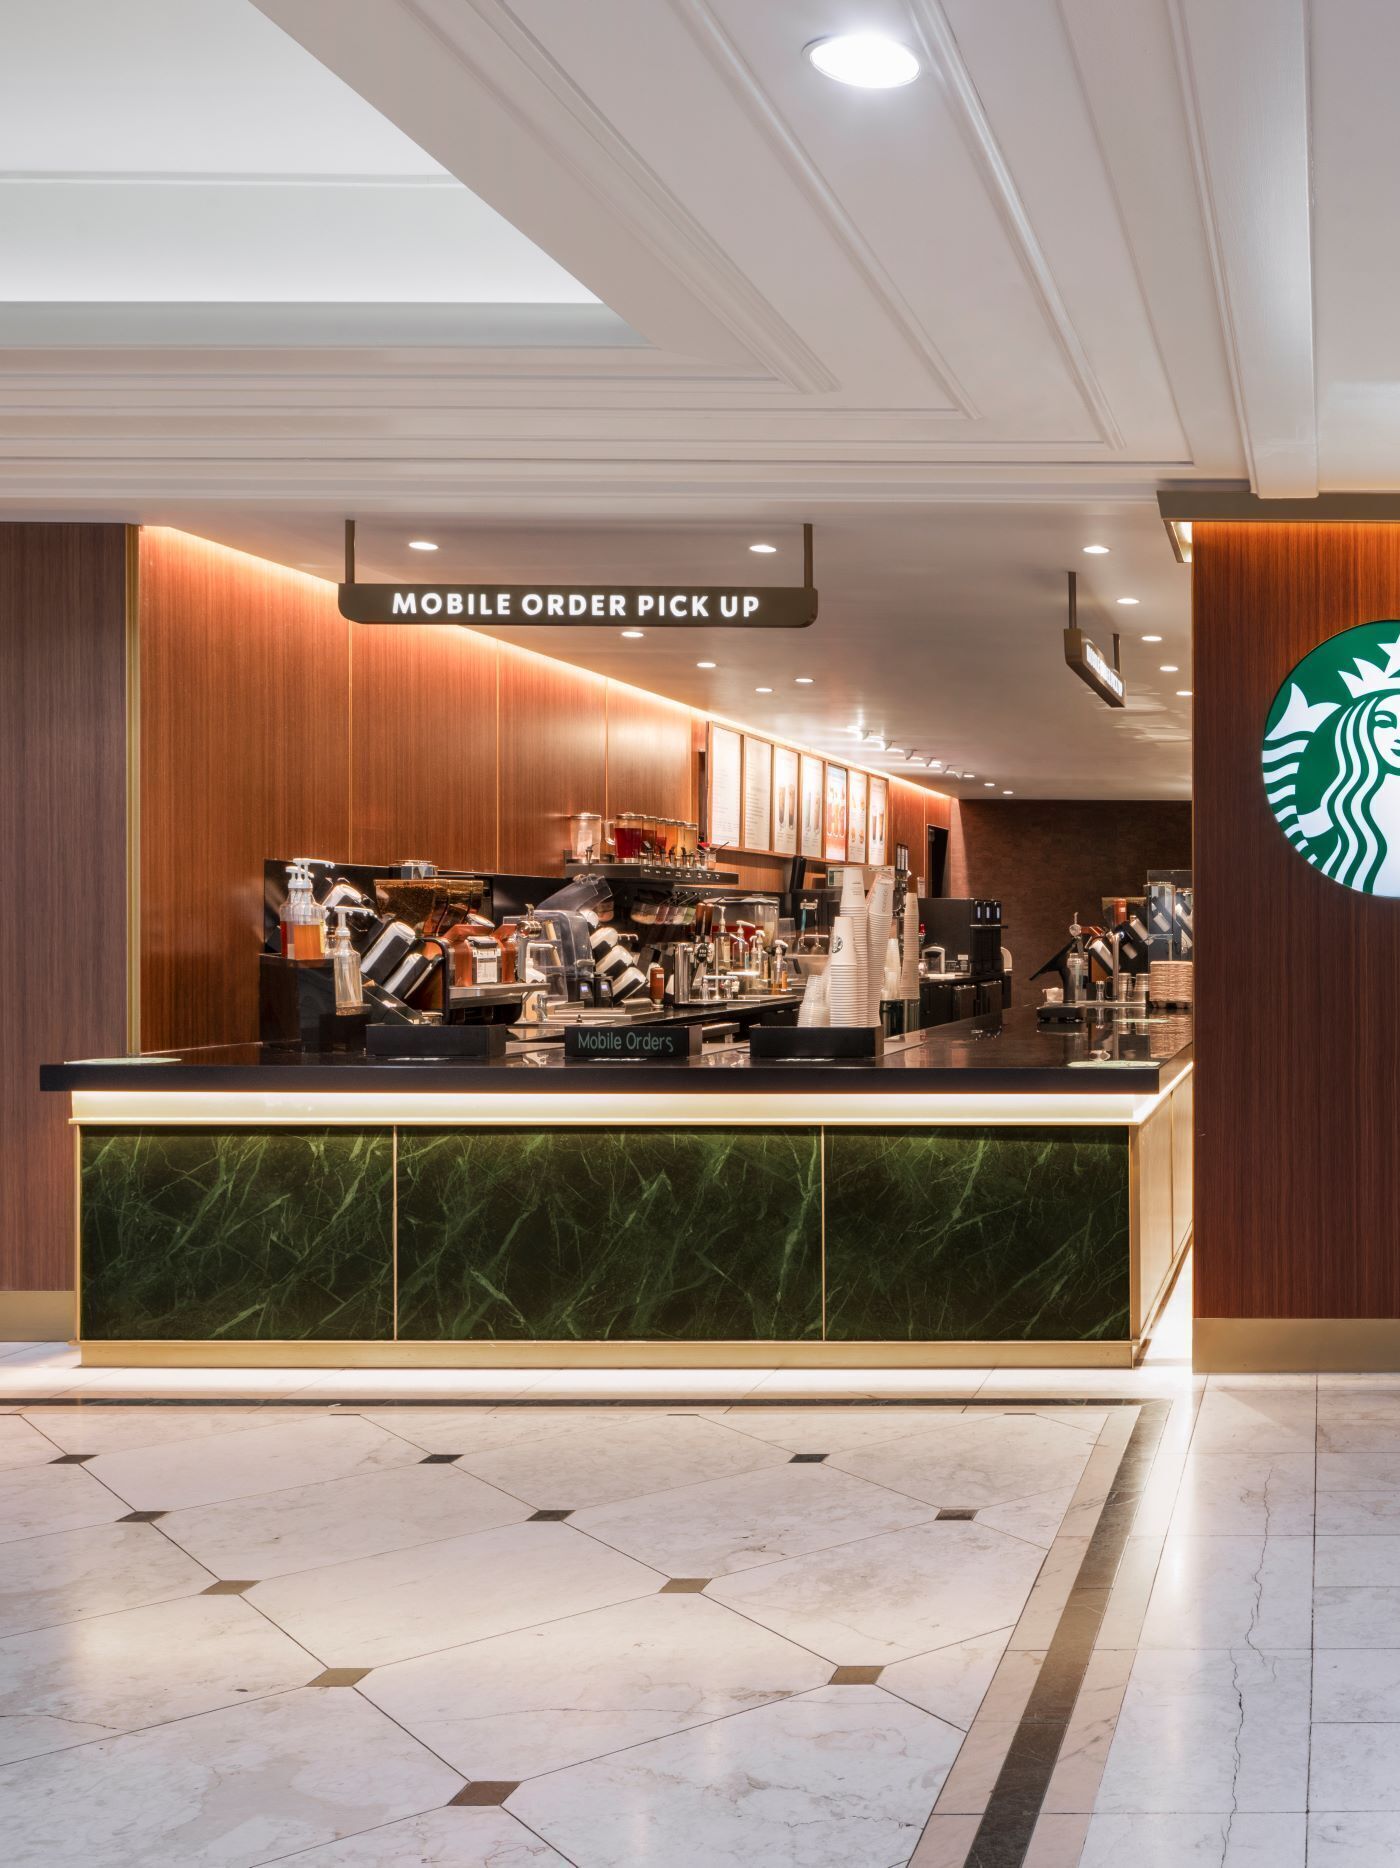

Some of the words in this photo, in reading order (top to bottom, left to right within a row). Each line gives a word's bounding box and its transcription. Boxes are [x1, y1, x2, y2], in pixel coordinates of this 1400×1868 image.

[391, 592, 511, 615] MOBILE
[521, 594, 626, 616] ORDER
[637, 595, 709, 616] PICK
[719, 596, 760, 617] UP
[578, 1031, 622, 1050] Mobile
[626, 1031, 674, 1053] Orders
